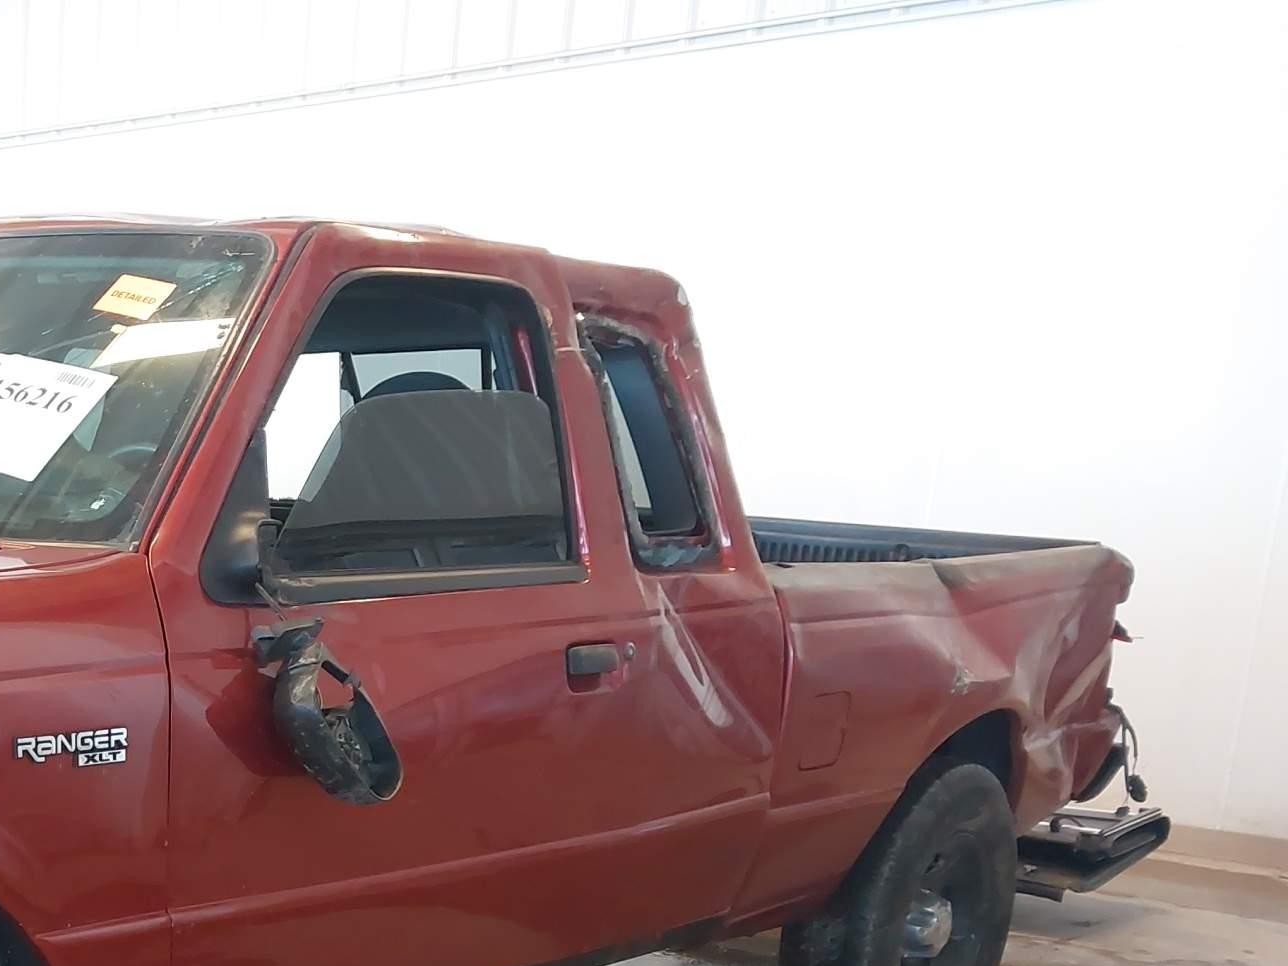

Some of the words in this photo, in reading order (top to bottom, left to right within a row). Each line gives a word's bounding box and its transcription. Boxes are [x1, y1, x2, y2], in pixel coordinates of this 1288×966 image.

[110, 289, 157, 305] DETAILED
[16, 727, 129, 763] RANGER
[82, 750, 123, 765] XLT
